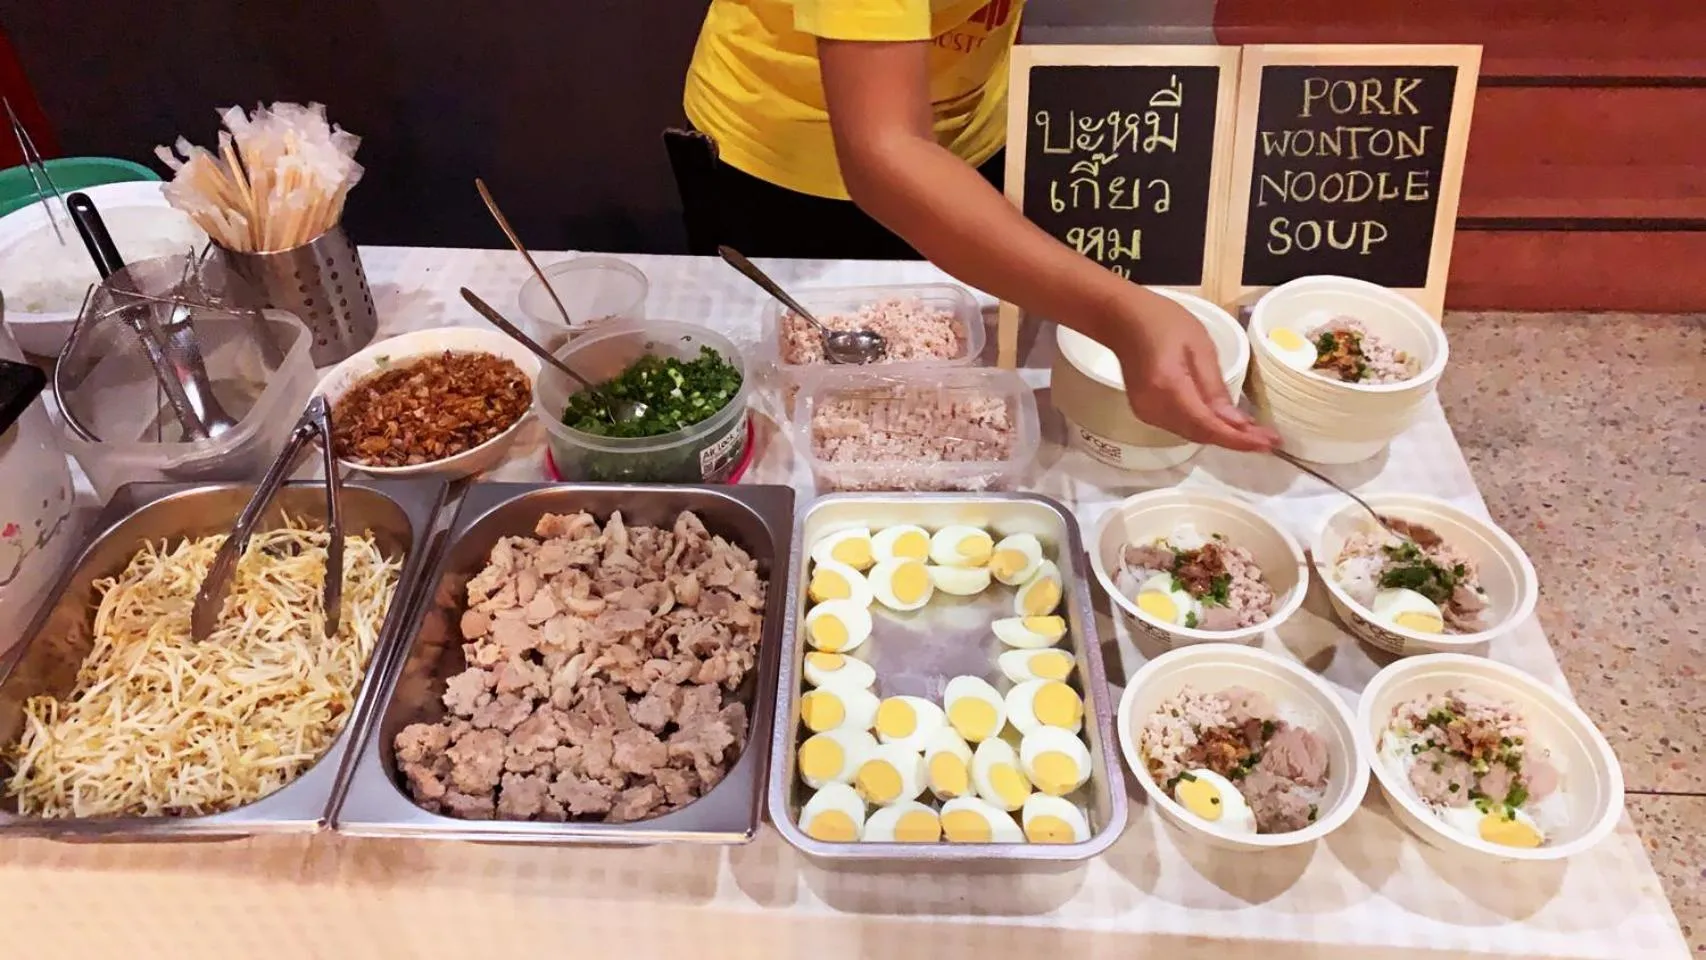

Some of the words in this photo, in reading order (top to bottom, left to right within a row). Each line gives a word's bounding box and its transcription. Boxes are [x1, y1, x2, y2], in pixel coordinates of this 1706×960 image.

[1035, 74, 1183, 154] บะหมี่
[1299, 77, 1423, 118] PORK
[1261, 126, 1434, 160] WONTON
[1257, 169, 1430, 207] NOODLE
[1267, 216, 1388, 255] SOUP
